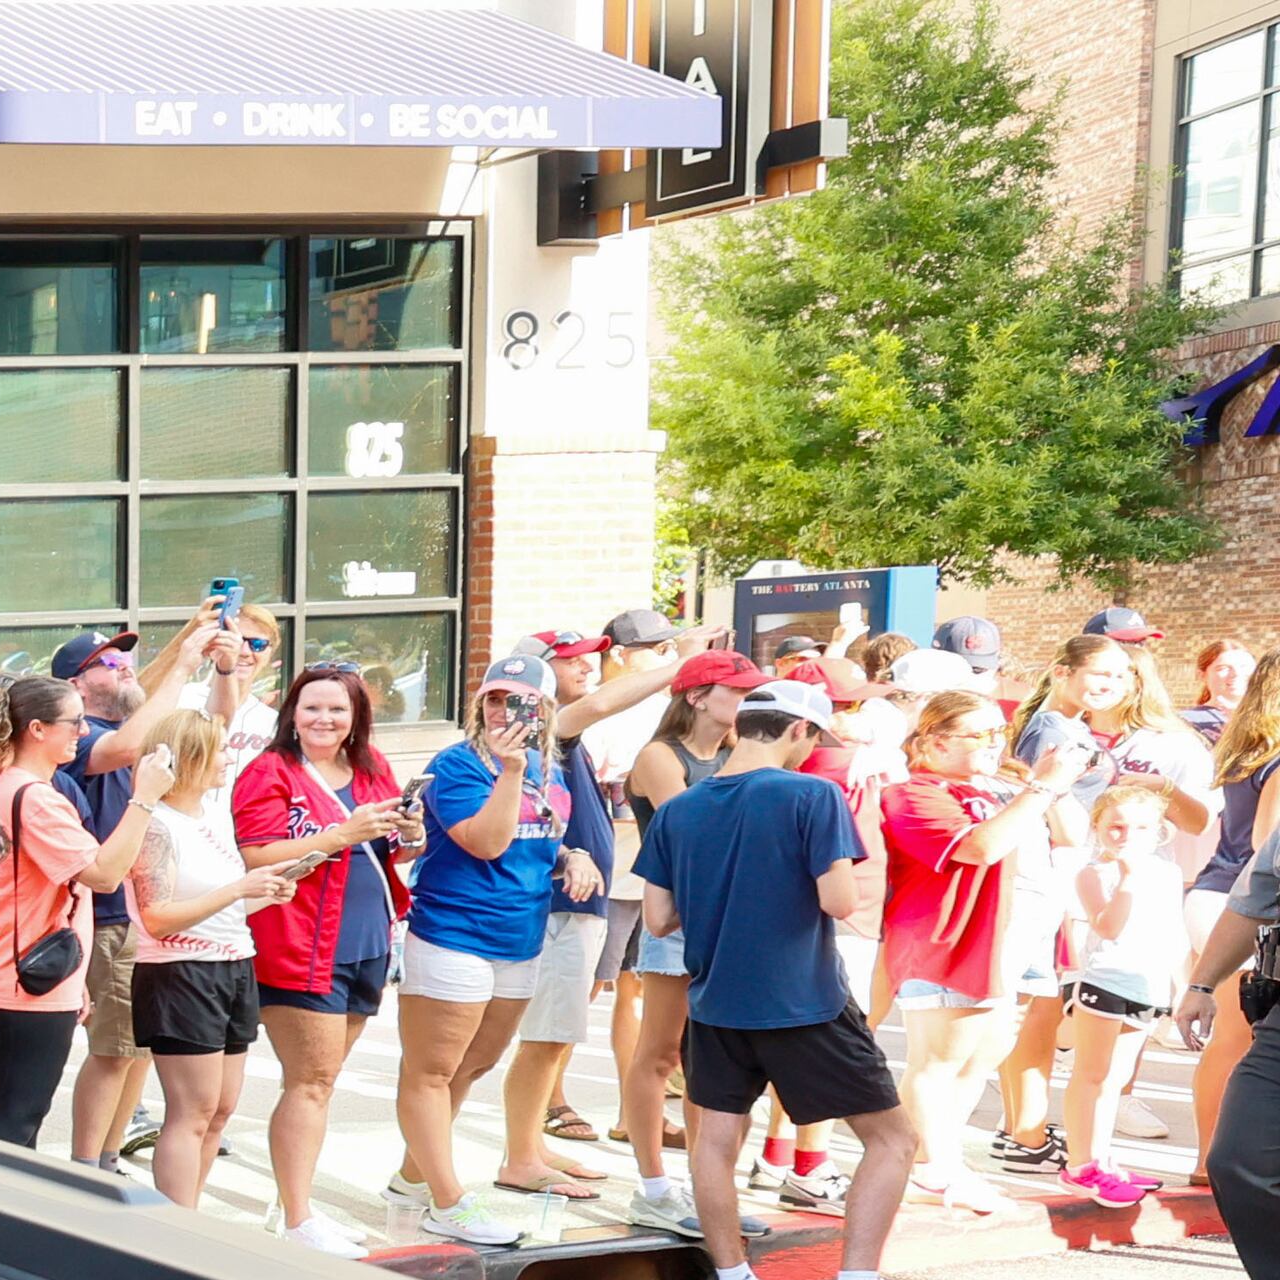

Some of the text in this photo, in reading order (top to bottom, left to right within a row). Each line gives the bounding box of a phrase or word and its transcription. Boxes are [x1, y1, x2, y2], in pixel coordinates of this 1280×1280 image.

[135, 100, 558, 140] EAT DRINK BE SOCIAL
[500, 309, 636, 371] 825
[751, 579, 871, 596] THE BATTERY ATLANTA
